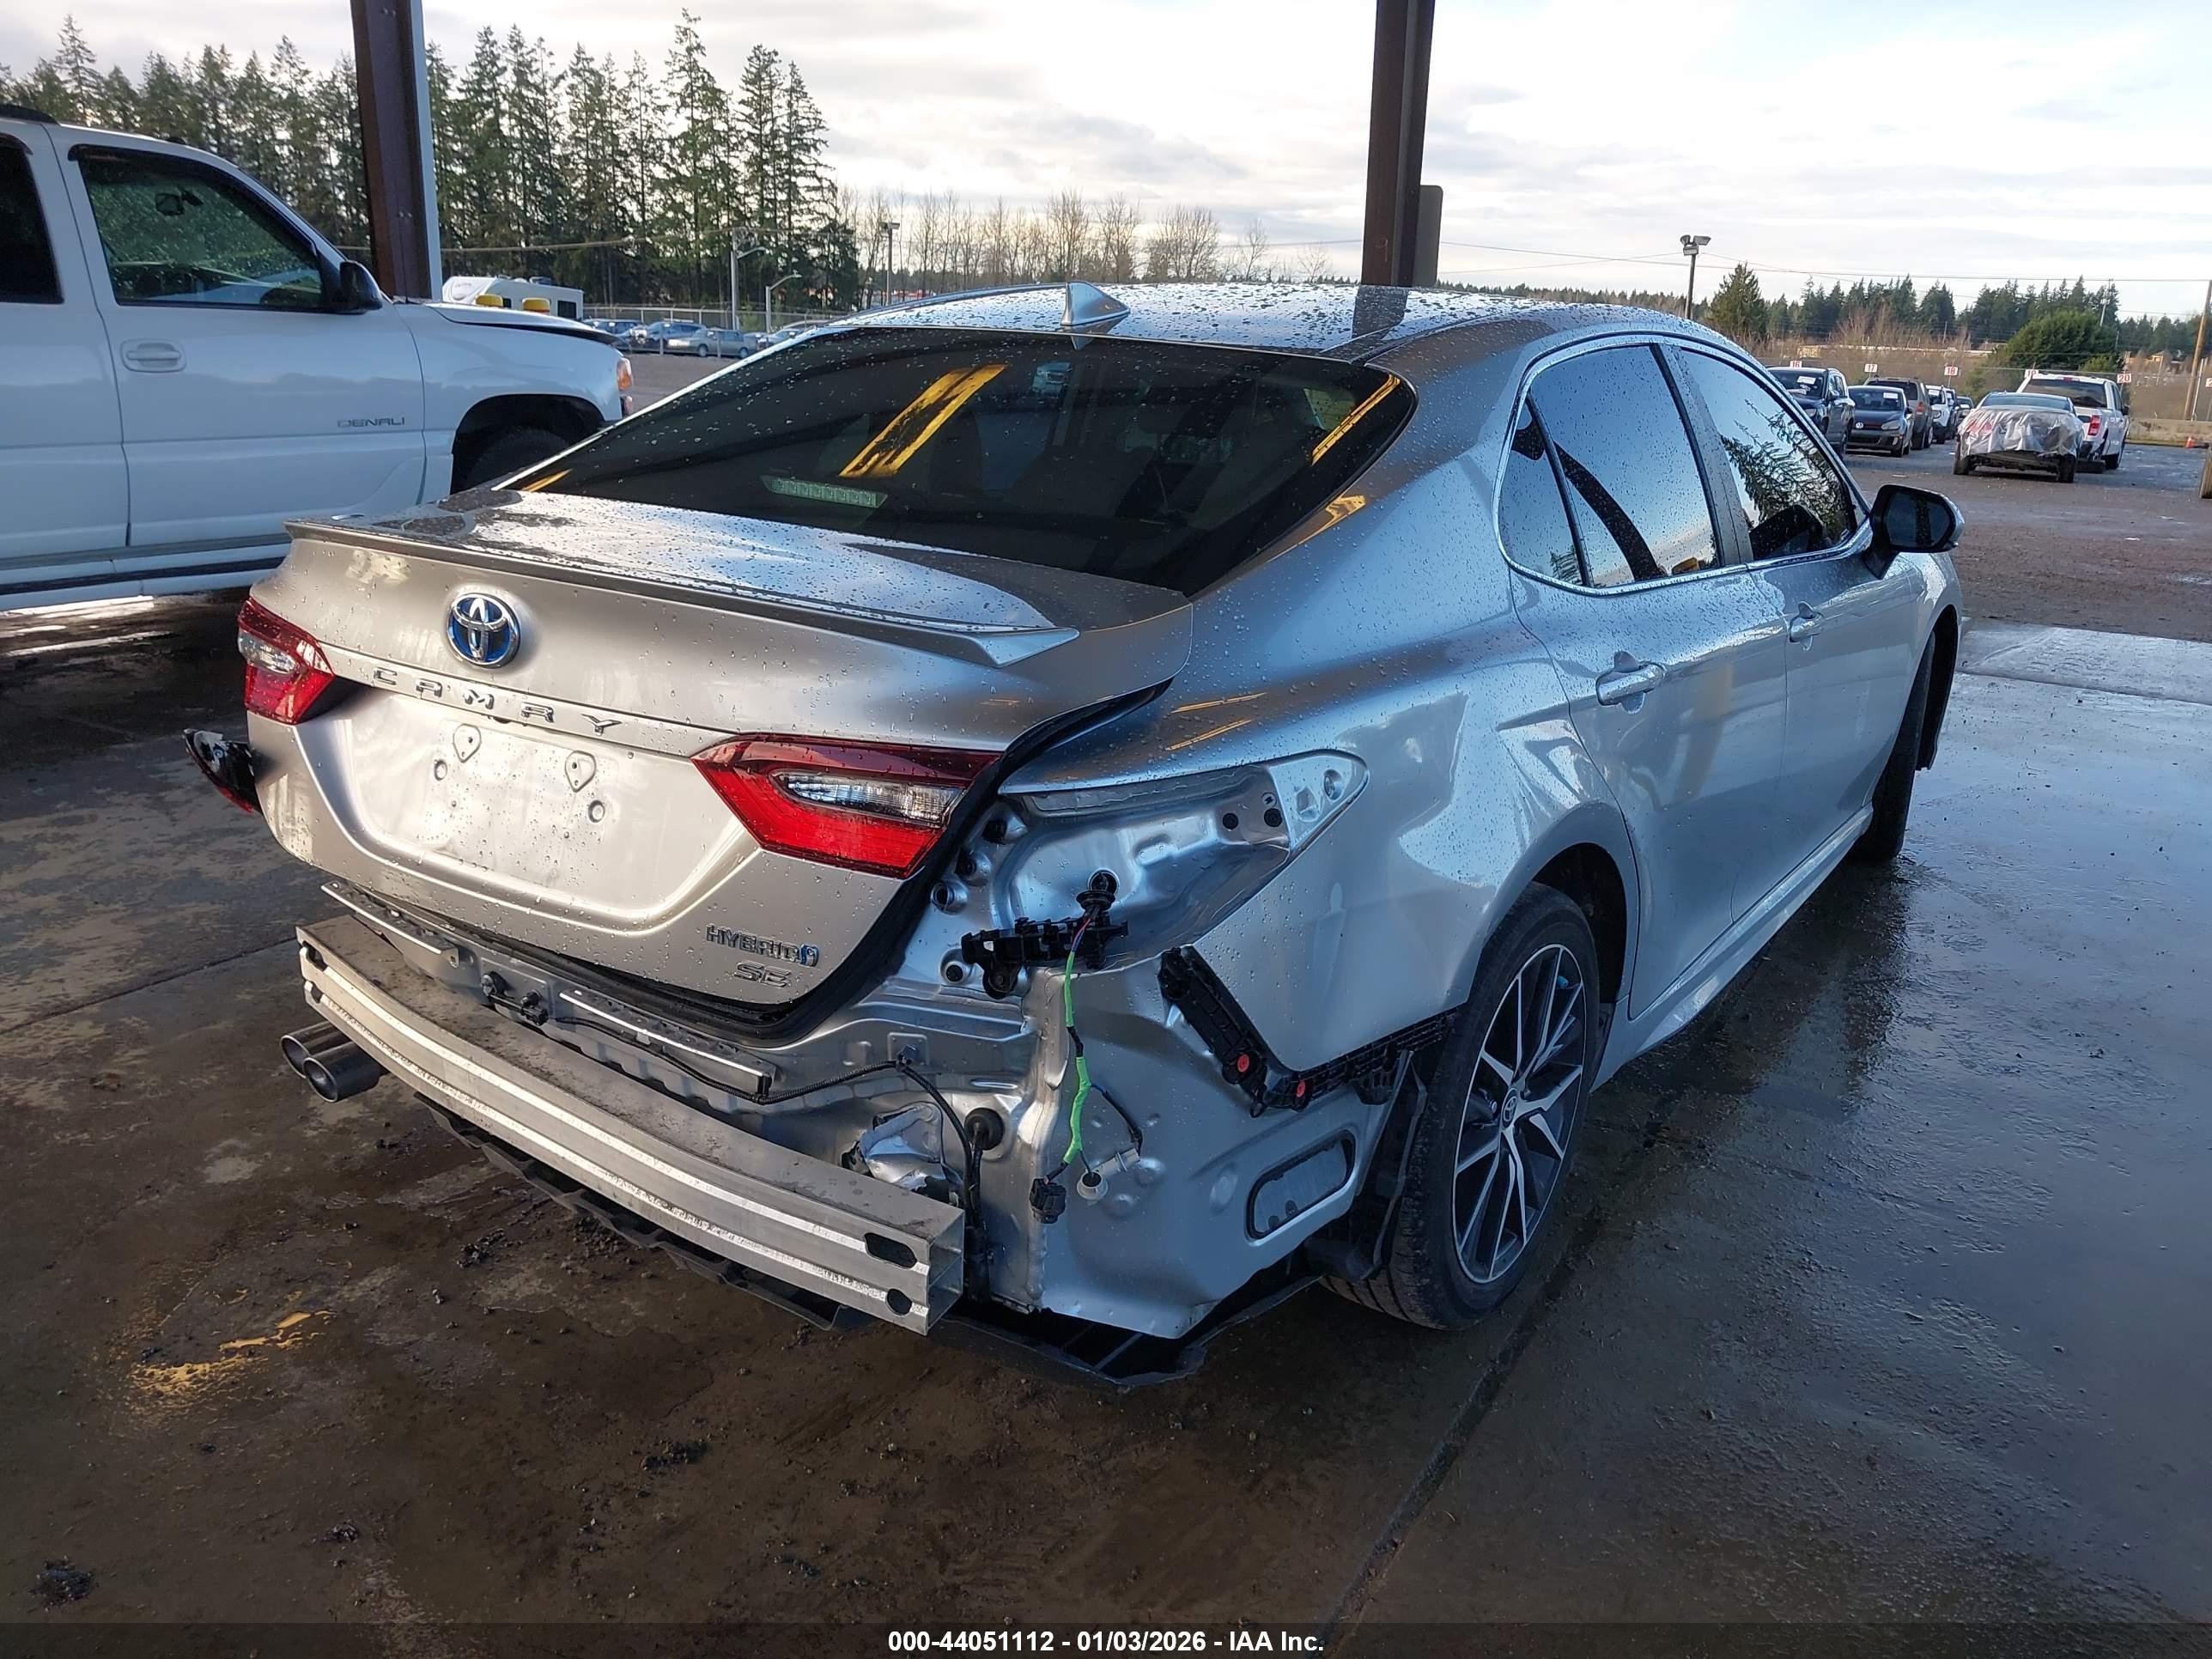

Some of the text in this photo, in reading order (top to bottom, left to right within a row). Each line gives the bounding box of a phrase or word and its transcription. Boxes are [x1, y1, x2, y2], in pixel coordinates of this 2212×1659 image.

[2118, 374, 2130, 383] 20
[337, 417, 404, 428] DENALI
[374, 666, 623, 735] CAMRY
[706, 923, 801, 963] HYBRID
[733, 960, 792, 988] SE
